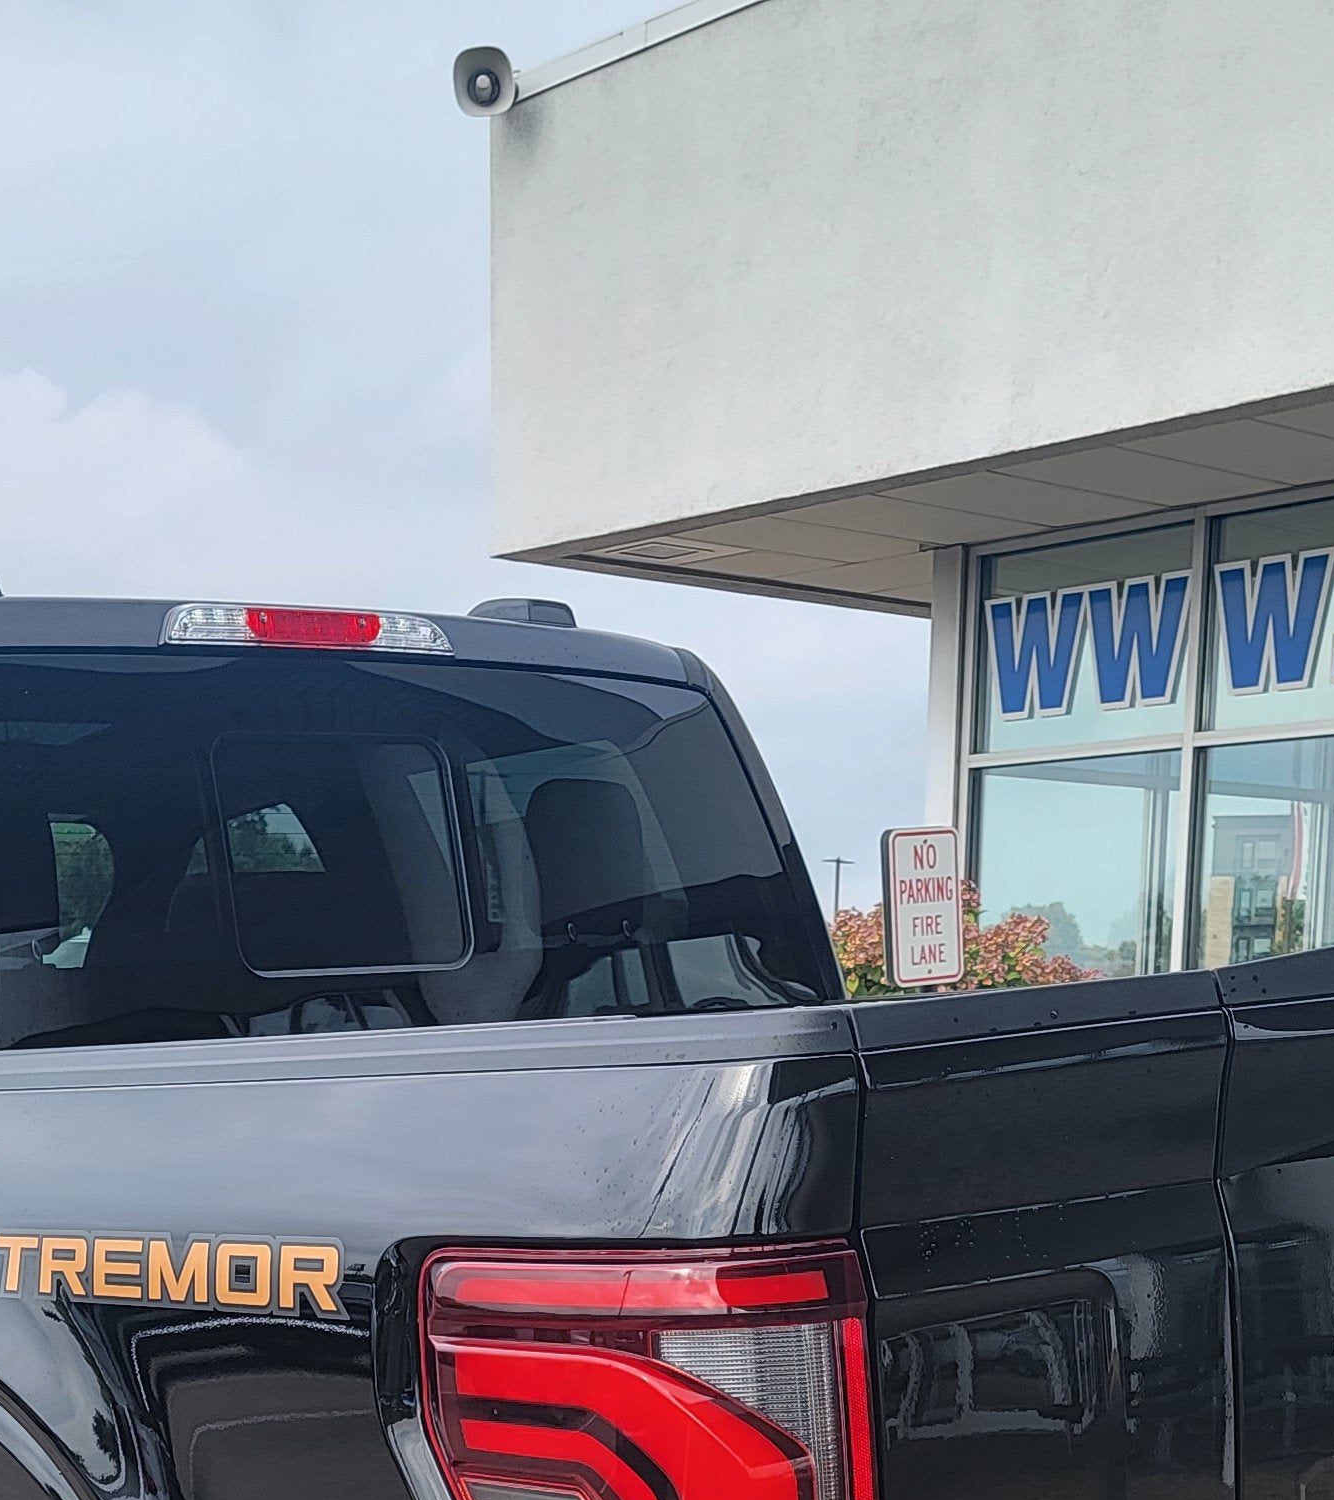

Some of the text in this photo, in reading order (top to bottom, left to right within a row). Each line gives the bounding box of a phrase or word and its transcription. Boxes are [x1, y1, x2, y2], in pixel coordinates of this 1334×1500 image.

[913, 844, 937, 870] NO
[899, 876, 954, 905] PARKING
[912, 914, 943, 937] FIRE
[911, 943, 946, 966] LANE
